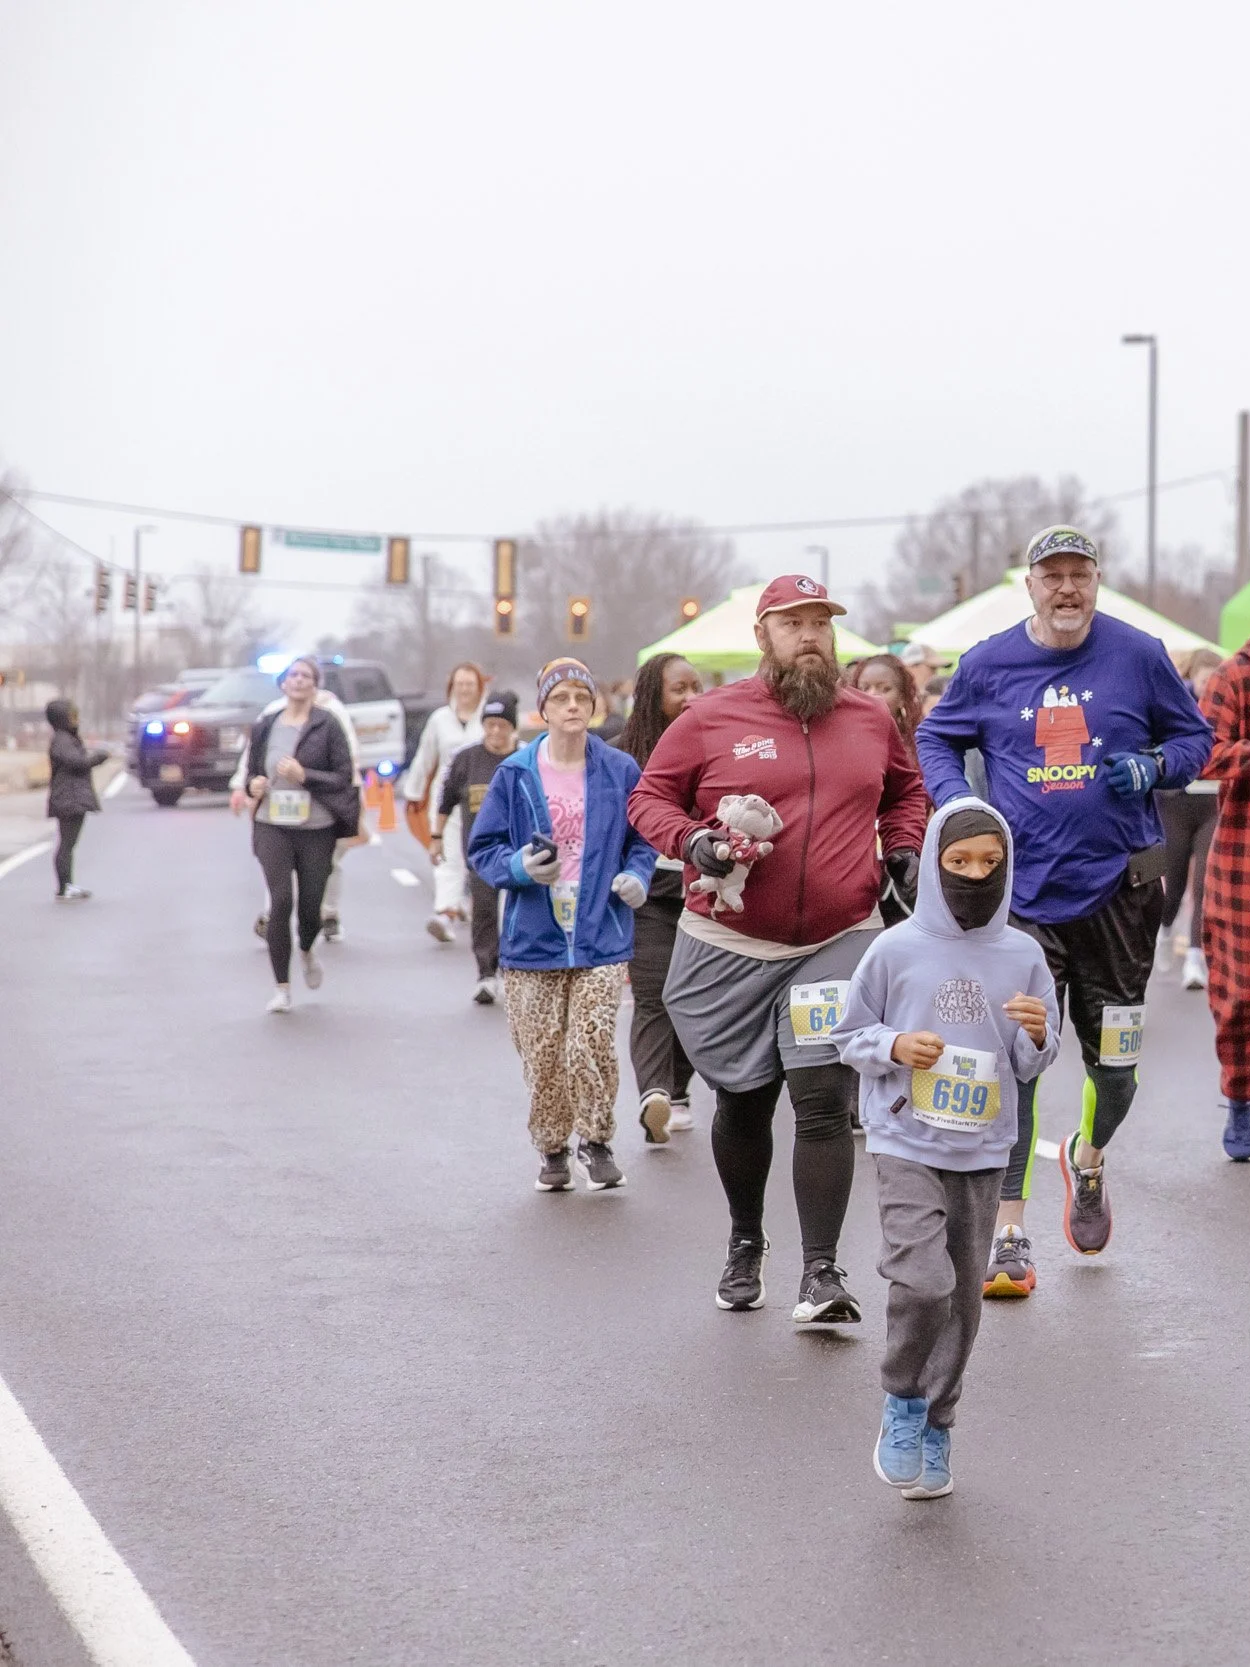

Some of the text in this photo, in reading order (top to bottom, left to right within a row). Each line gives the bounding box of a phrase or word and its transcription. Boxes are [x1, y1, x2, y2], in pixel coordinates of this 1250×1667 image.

[1027, 764, 1098, 784] SNOOPY
[1041, 781, 1086, 794] Season
[943, 979, 982, 994] THE
[809, 1006, 843, 1032] 64
[932, 1078, 988, 1116] 699
